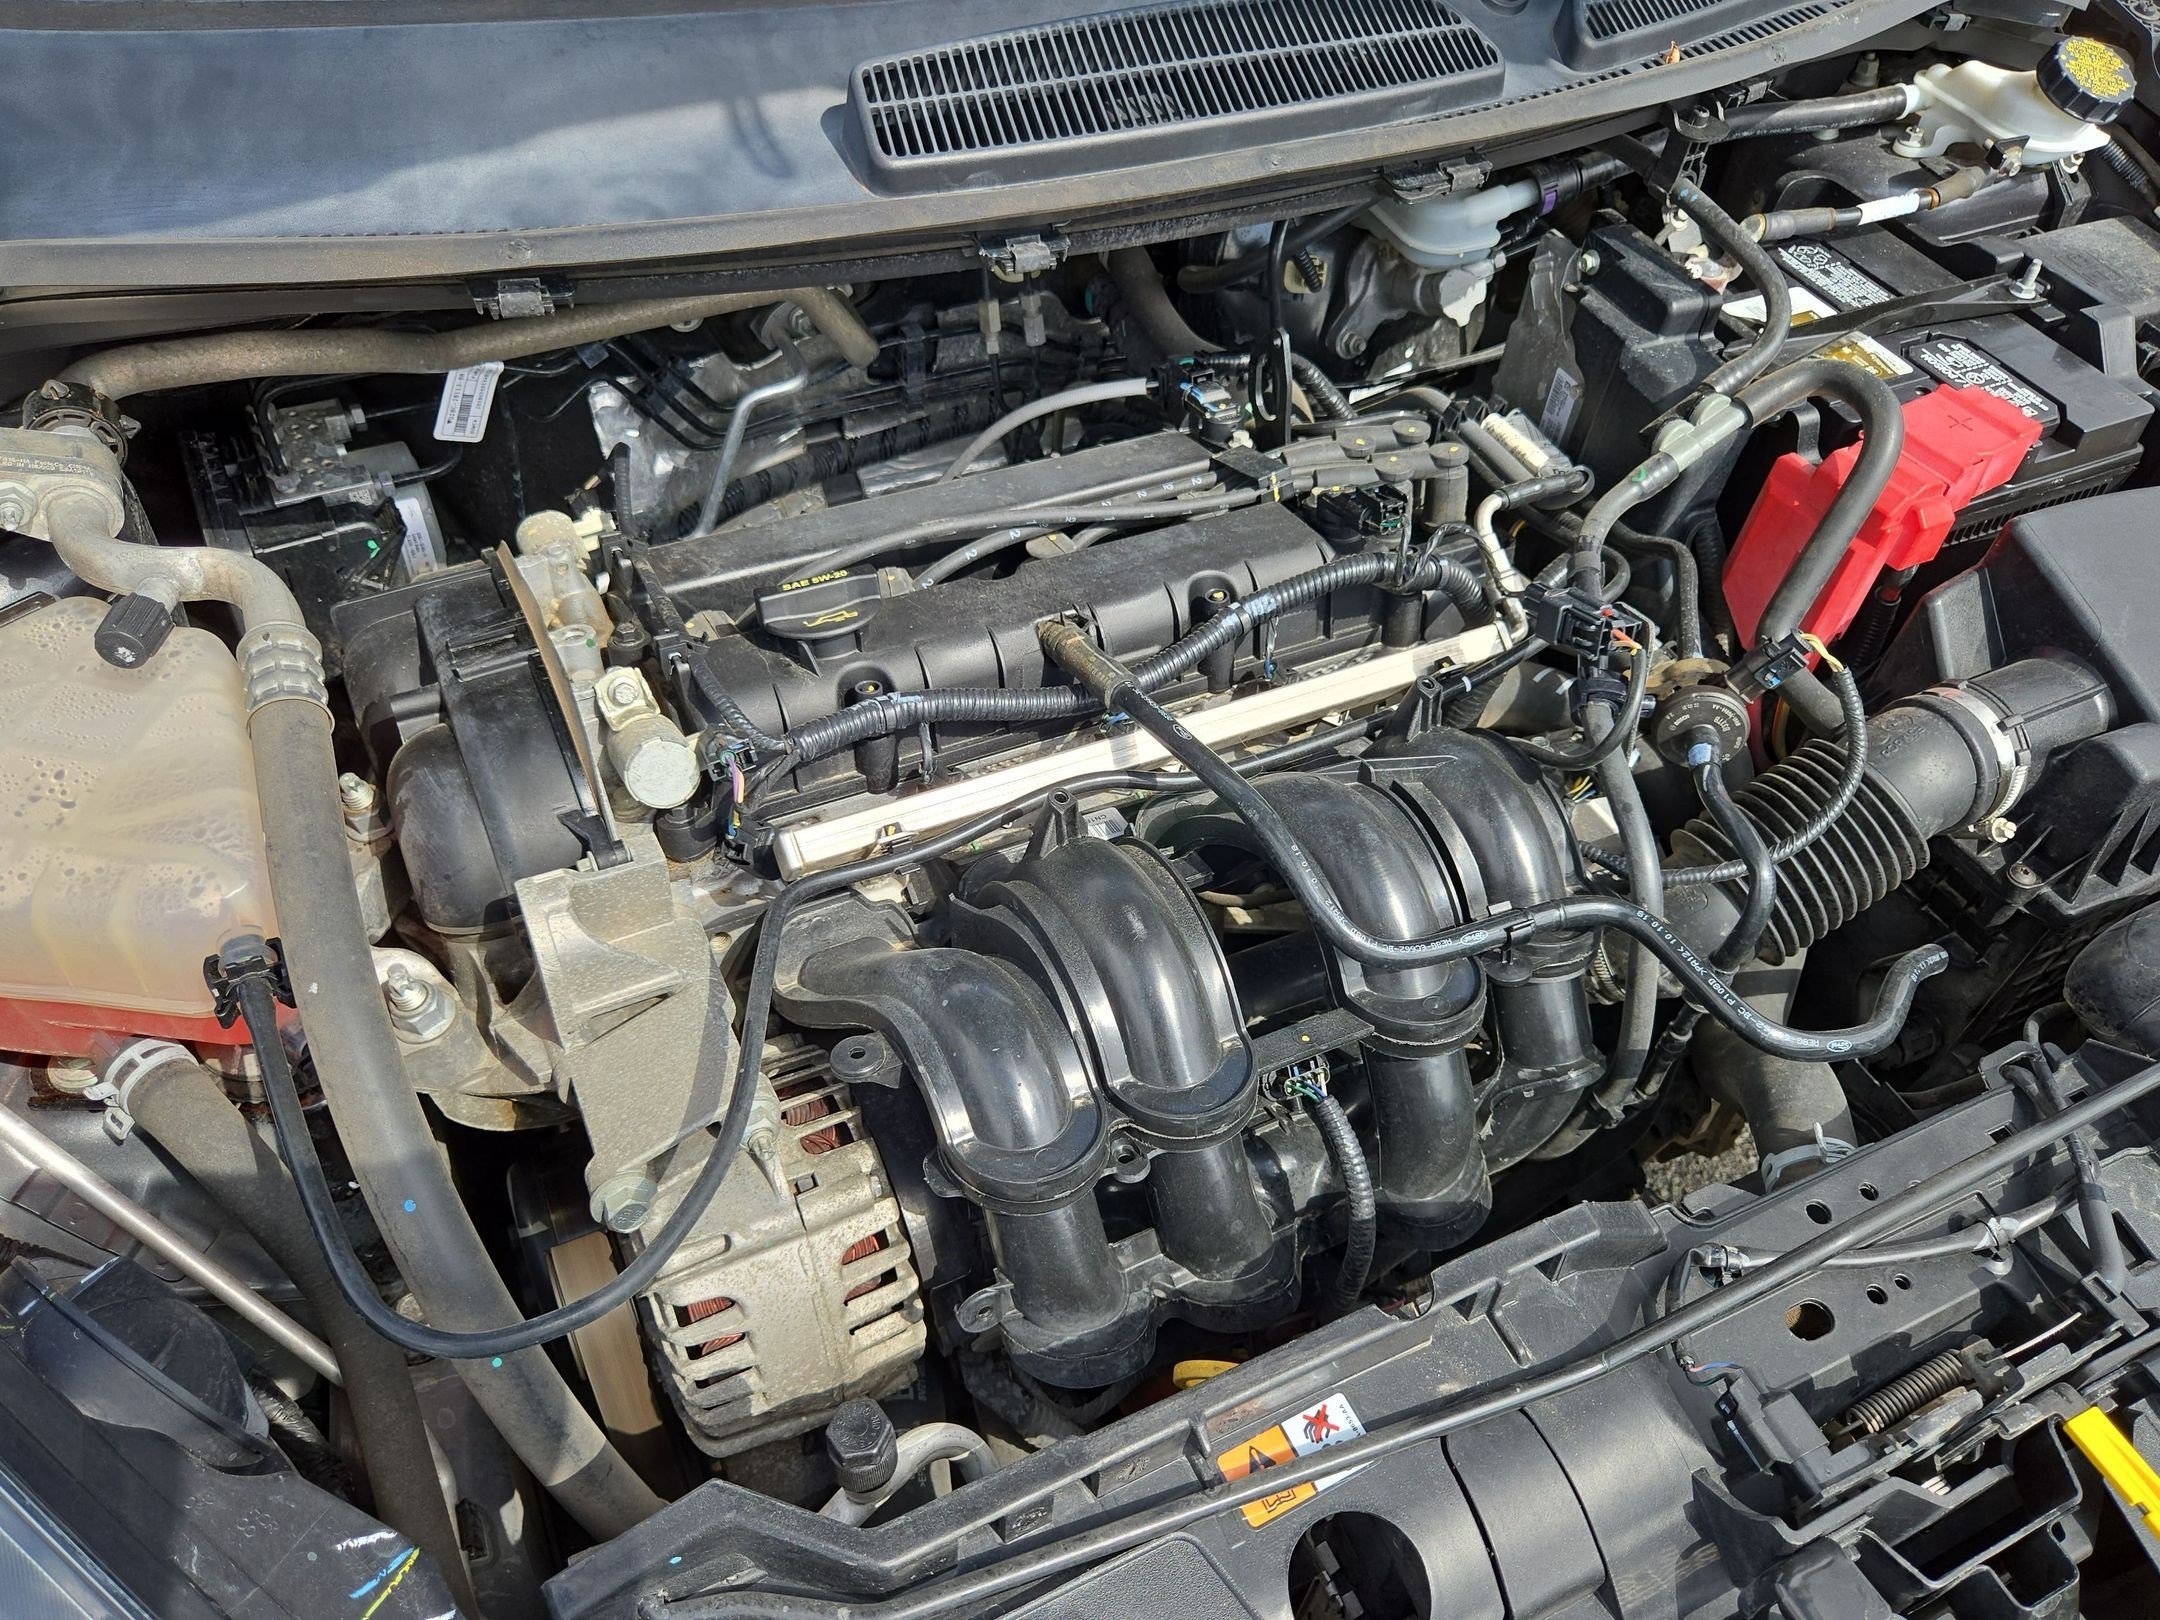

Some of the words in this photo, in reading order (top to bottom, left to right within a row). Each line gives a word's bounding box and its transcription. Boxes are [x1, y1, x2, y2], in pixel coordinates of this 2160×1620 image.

[782, 579, 810, 591] SAE
[811, 569, 849, 584] 5W-20
[1677, 945, 1708, 976] >PA12<
[1707, 978, 1736, 1006] P108D
